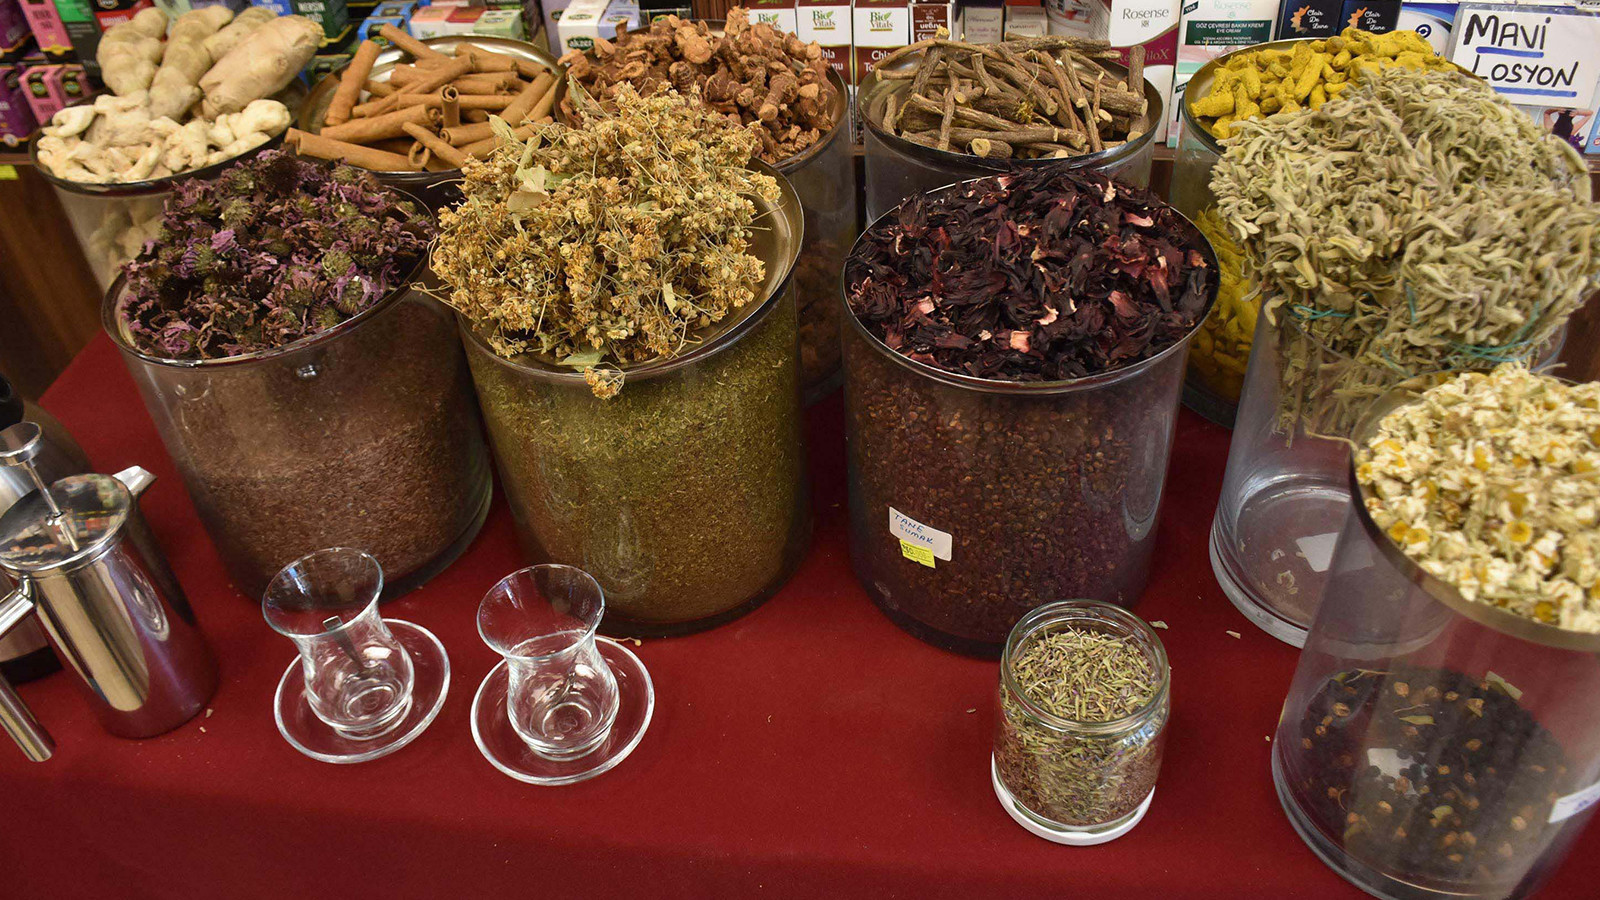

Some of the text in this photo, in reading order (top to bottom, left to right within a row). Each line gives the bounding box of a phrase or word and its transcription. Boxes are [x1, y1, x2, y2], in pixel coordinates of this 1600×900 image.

[1122, 8, 1169, 19] Rosense
[813, 19, 836, 27] Vitals
[870, 20, 894, 28] Vitals
[822, 49, 835, 58] hia
[1471, 54, 1579, 87] LOSYON
[895, 513, 925, 533] TANE
